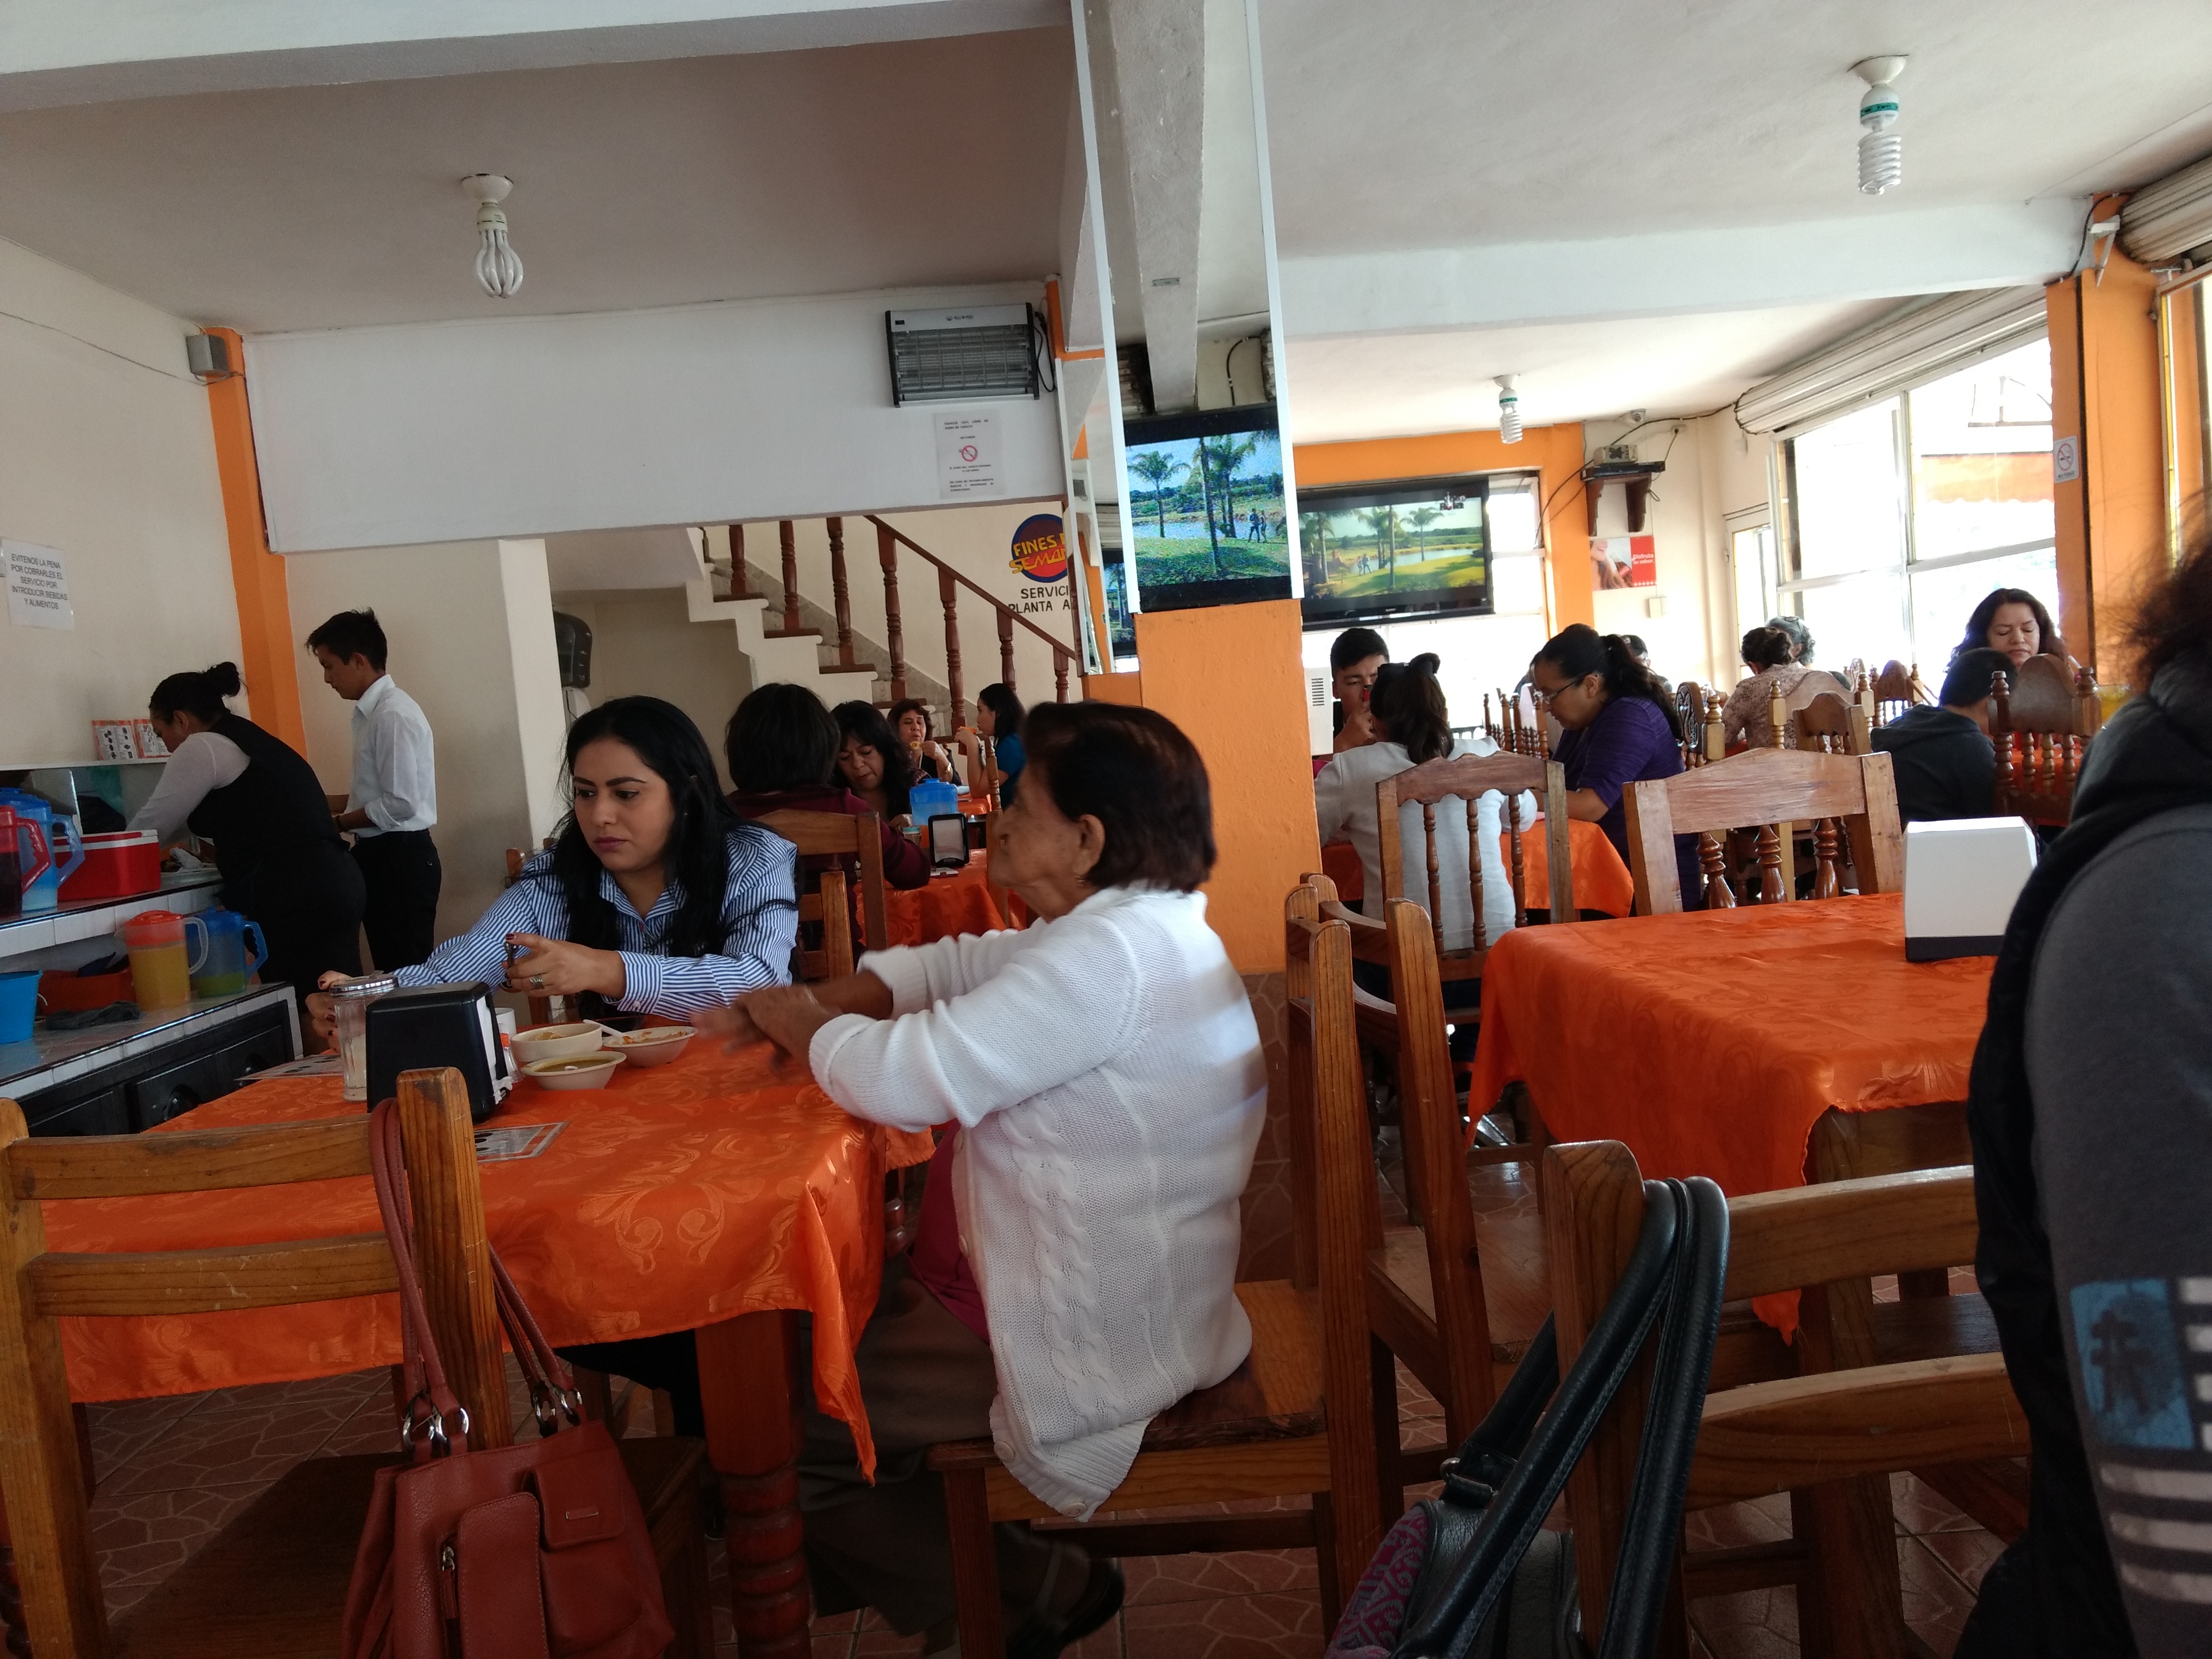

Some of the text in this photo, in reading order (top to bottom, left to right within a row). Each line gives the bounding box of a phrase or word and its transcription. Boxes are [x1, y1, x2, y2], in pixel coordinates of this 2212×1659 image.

[1013, 534, 1058, 557] FINES
[12, 553, 38, 565] EVITENOS
[47, 560, 61, 569] PENA
[11, 564, 63, 580] POR COBRARLES EL
[21, 576, 58, 589] SERVICIO POR
[12, 586, 68, 601] INTRODUCIR BEBIDAS
[29, 599, 59, 610] ALIMENTOS
[1008, 601, 1053, 613] PLANTA
